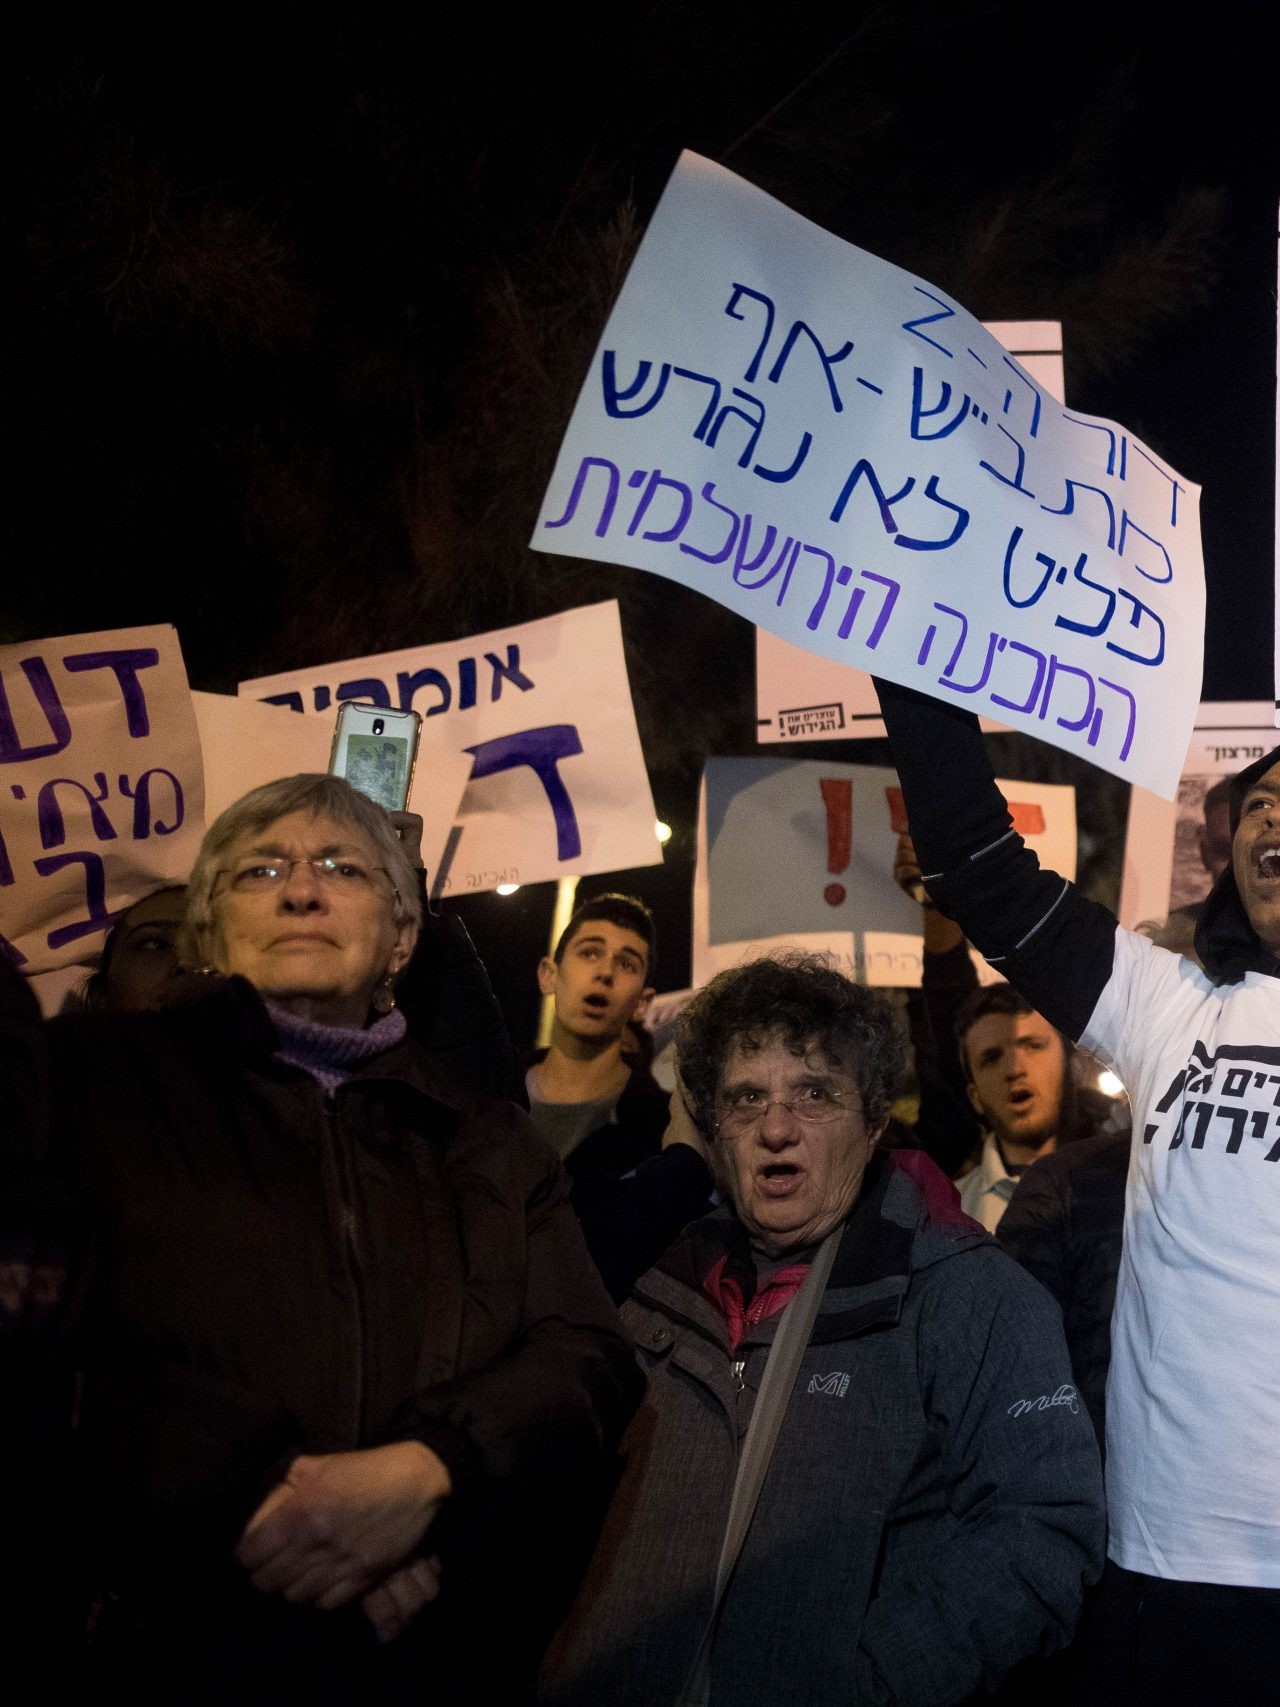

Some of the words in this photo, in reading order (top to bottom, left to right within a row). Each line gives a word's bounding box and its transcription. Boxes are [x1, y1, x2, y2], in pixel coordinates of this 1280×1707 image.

[602, 349, 813, 484] נגרש
[829, 459, 971, 551] לא
[1003, 526, 1166, 667] פליט
